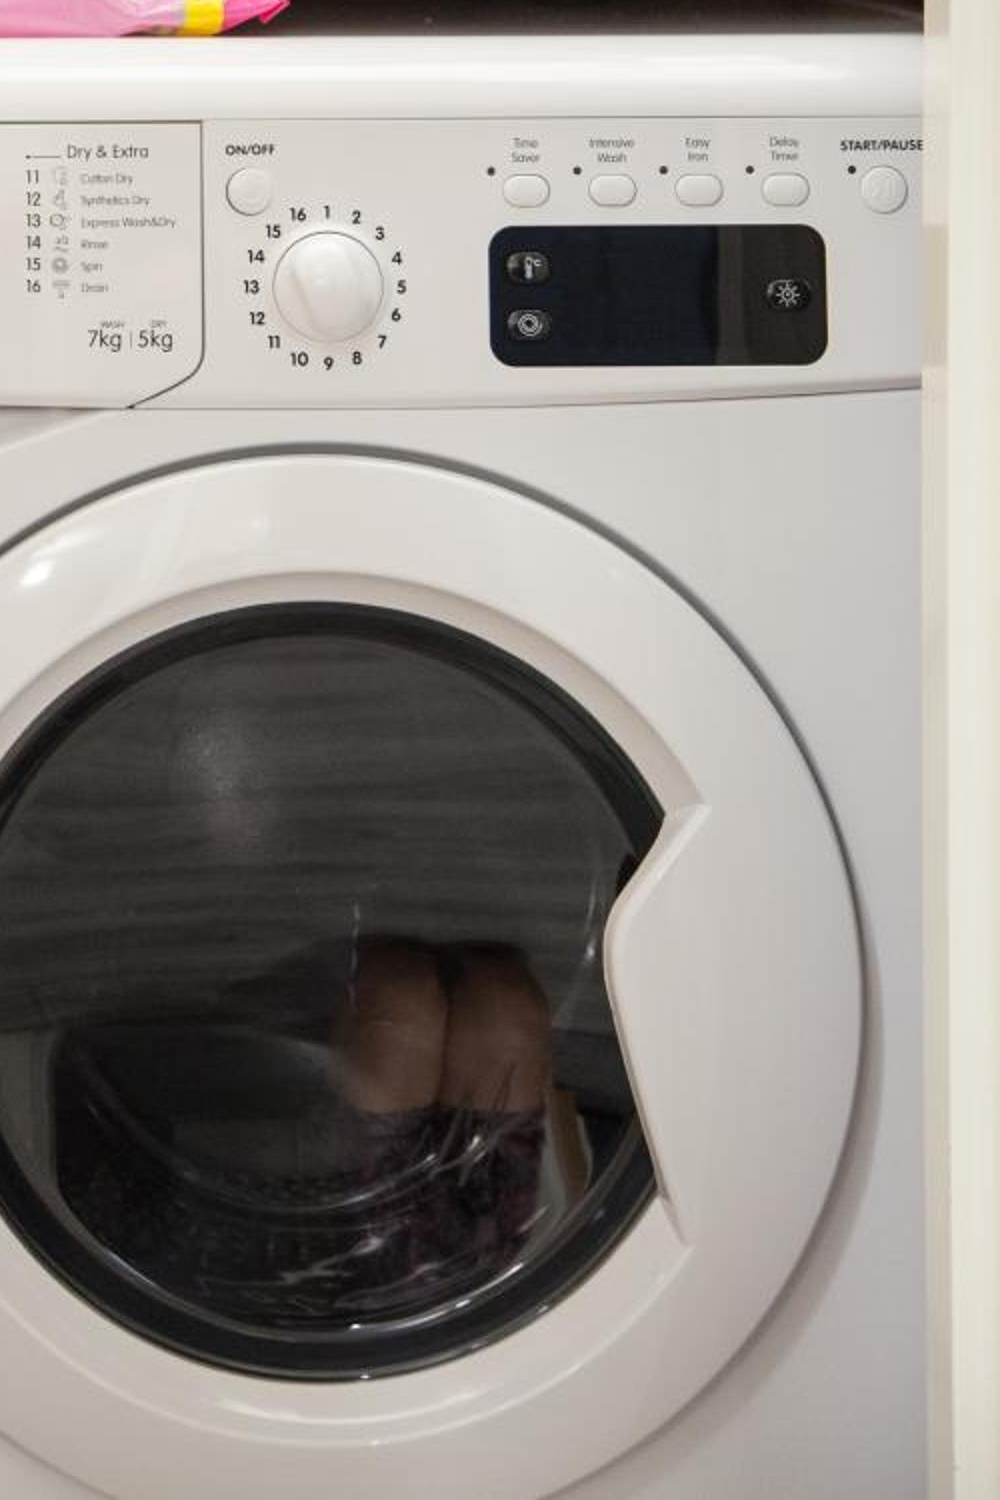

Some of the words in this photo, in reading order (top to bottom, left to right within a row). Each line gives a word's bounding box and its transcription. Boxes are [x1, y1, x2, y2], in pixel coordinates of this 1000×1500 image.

[225, 143, 276, 157] ON/OFF
[512, 137, 539, 150] Time
[588, 137, 636, 150] Intensive
[685, 136, 711, 151] Easy
[768, 136, 799, 149] Delay
[839, 139, 924, 152] START/PAUSE
[66, 144, 93, 161] Dry
[95, 145, 108, 159] &
[112, 144, 150, 160] Extra
[597, 151, 628, 164] Wash
[687, 151, 710, 163] Iron
[25, 169, 40, 185] 11
[26, 191, 41, 207] 12
[132, 195, 151, 208] Dry
[290, 207, 307, 222] 16
[323, 205, 331, 220] 1
[351, 210, 362, 225] 2
[26, 213, 41, 229] 13
[266, 224, 282, 239] 15
[375, 226, 385, 241] 3
[26, 235, 41, 250] 14
[247, 249, 265, 264] 14
[391, 250, 403, 266] 4
[26, 257, 41, 272] 15
[26, 279, 41, 294] 16
[243, 279, 260, 295] 13
[396, 280, 407, 295] 5
[249, 311, 266, 327] 12
[391, 308, 401, 323] 6
[87, 329, 122, 353] 7kg
[137, 329, 173, 353] 5kg
[267, 334, 281, 349] 11
[377, 334, 388, 350] 7
[290, 352, 309, 367] 10
[323, 356, 334, 371] 9
[351, 351, 363, 366] 8
